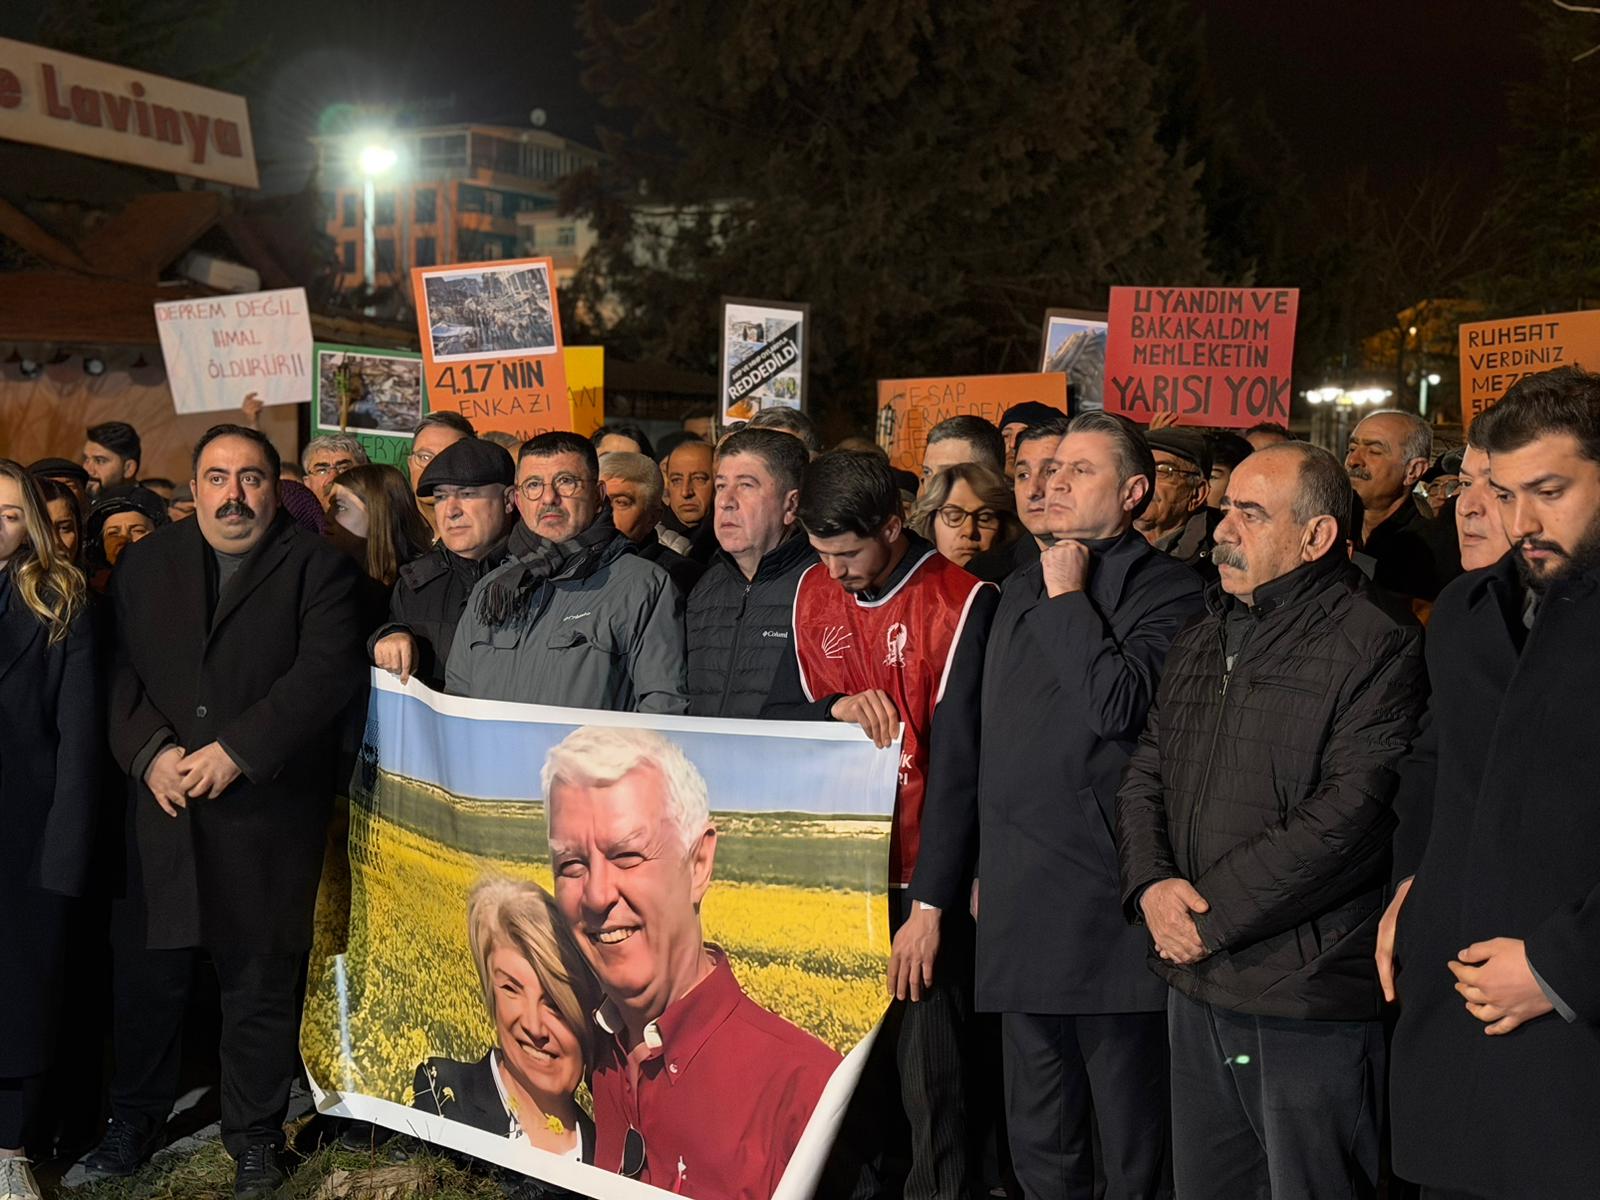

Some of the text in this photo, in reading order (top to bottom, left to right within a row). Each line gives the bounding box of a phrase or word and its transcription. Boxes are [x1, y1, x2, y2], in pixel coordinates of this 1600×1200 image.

[41, 63, 242, 164] Lavinya
[156, 303, 226, 321] DEPREM
[1134, 290, 1289, 315] UYANDIM VE
[1131, 315, 1270, 340] BAKAKALDIM
[1468, 322, 1559, 348] RUHSAT
[1133, 341, 1269, 368] MEMLEKETİN
[435, 359, 545, 395] 4.17'NİN
[728, 340, 799, 400] REDDEDİLDİ
[459, 394, 551, 419] ENKAZI
[1111, 375, 1290, 417] YARISI YOK
